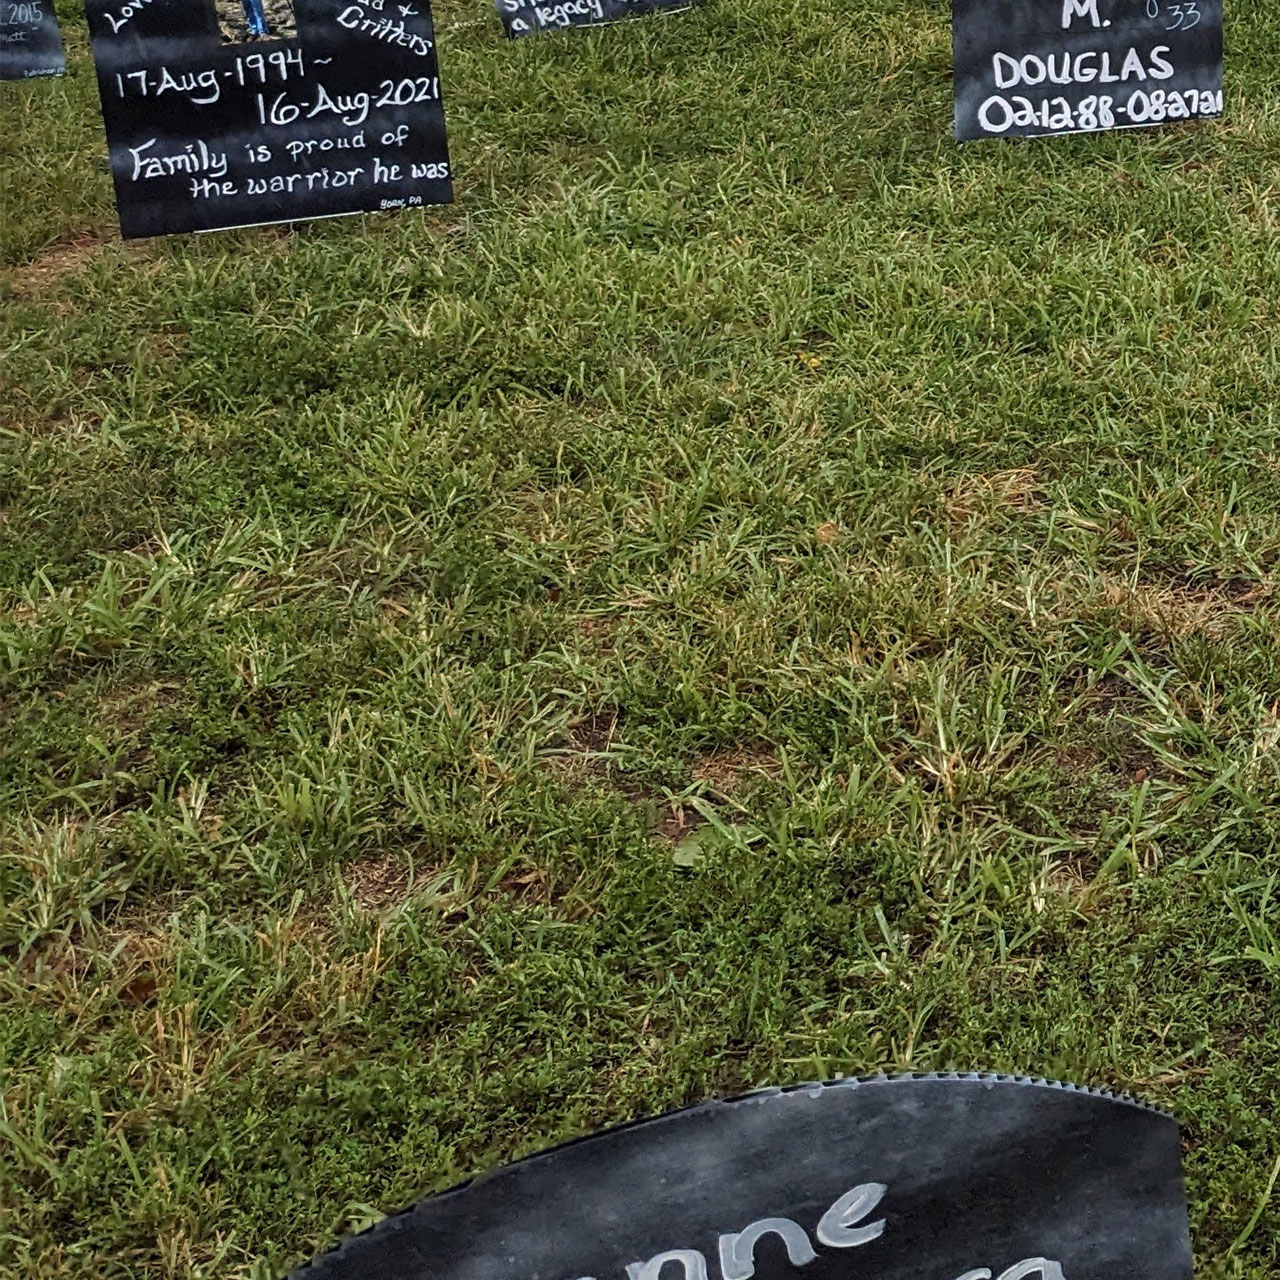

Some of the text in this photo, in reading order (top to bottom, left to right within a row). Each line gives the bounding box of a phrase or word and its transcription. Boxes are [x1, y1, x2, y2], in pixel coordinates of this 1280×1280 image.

[336, 5, 433, 57] Critters
[511, 13, 530, 32] a
[1164, 2, 1202, 32] 33
[992, 45, 1175, 90] DOUGLAS
[256, 76, 441, 127] 16-Aug-2021
[129, 125, 410, 182] Family is proud of
[190, 158, 449, 199] the warrior he was
